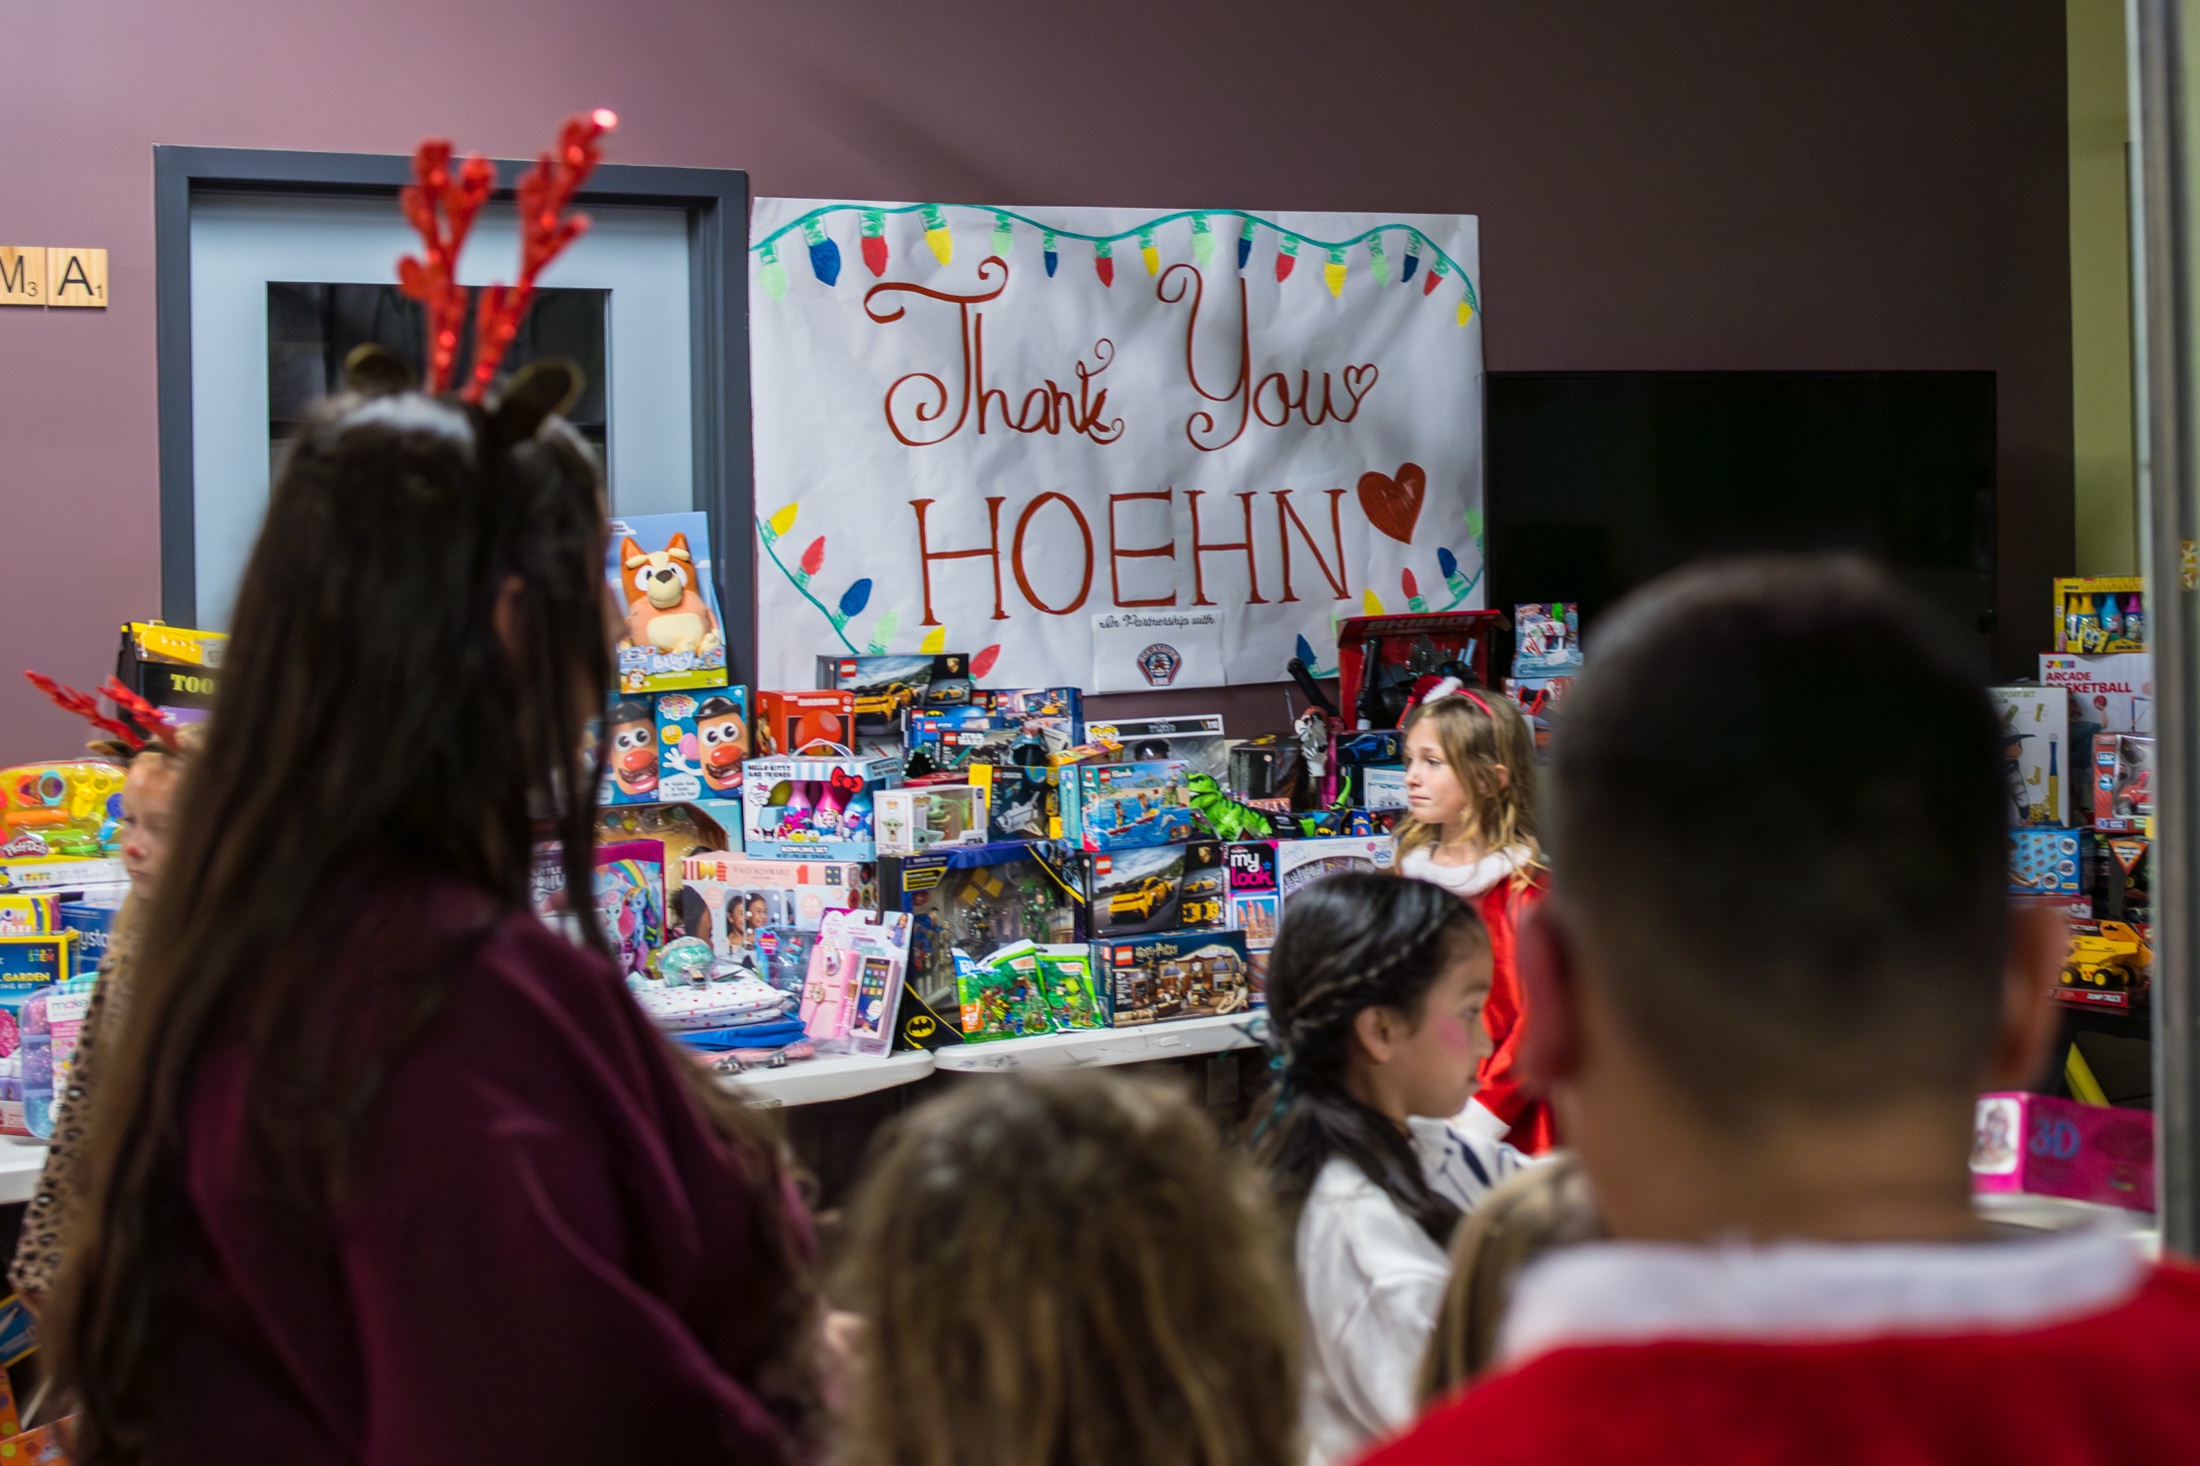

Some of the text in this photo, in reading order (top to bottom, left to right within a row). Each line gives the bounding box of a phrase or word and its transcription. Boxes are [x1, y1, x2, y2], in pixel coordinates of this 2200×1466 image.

[864, 255, 1378, 452] Thank You
[908, 487, 1353, 627] HOEHN
[2046, 672, 2092, 681] ARCADE
[2046, 682, 2133, 693] SKETBALL
[1230, 852, 1260, 873] my
[1231, 865, 1275, 887] look
[3, 972, 50, 982] GARDEN
